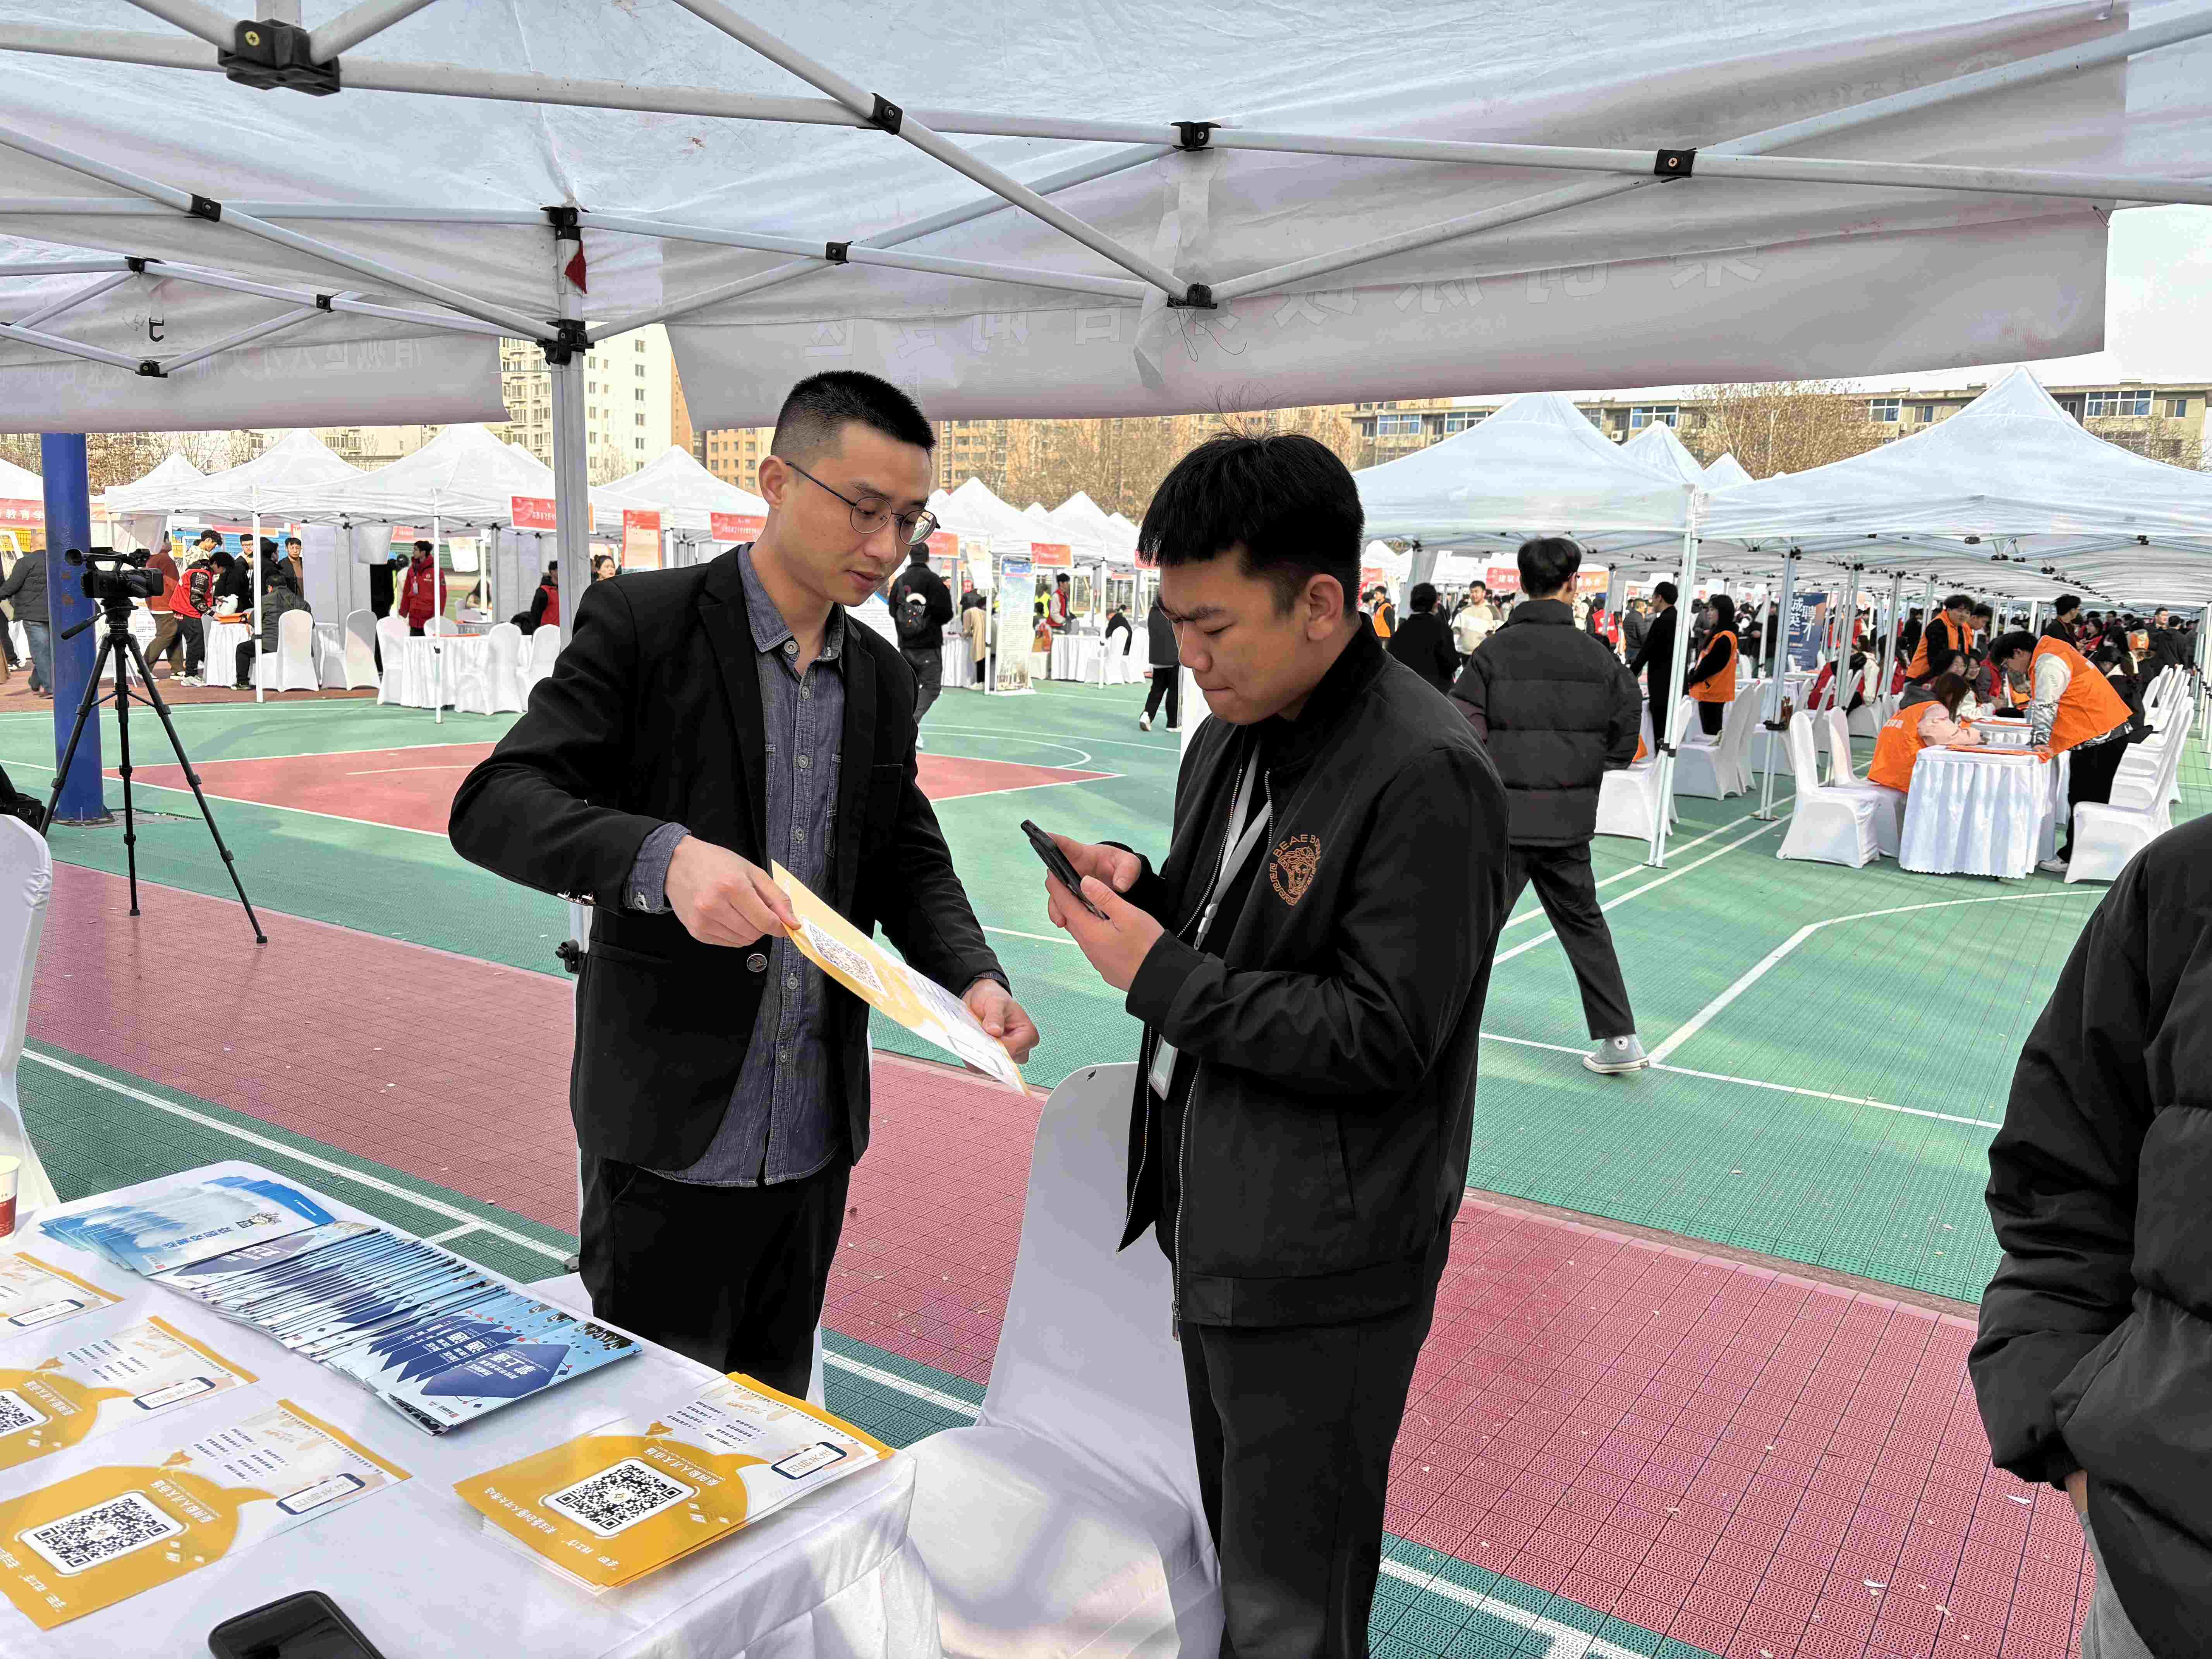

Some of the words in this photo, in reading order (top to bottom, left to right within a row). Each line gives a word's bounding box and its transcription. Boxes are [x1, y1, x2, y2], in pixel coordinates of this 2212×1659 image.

[489, 1352, 537, 1375] 掌上通
[644, 1446, 720, 1487] 秦创原人才大市场
